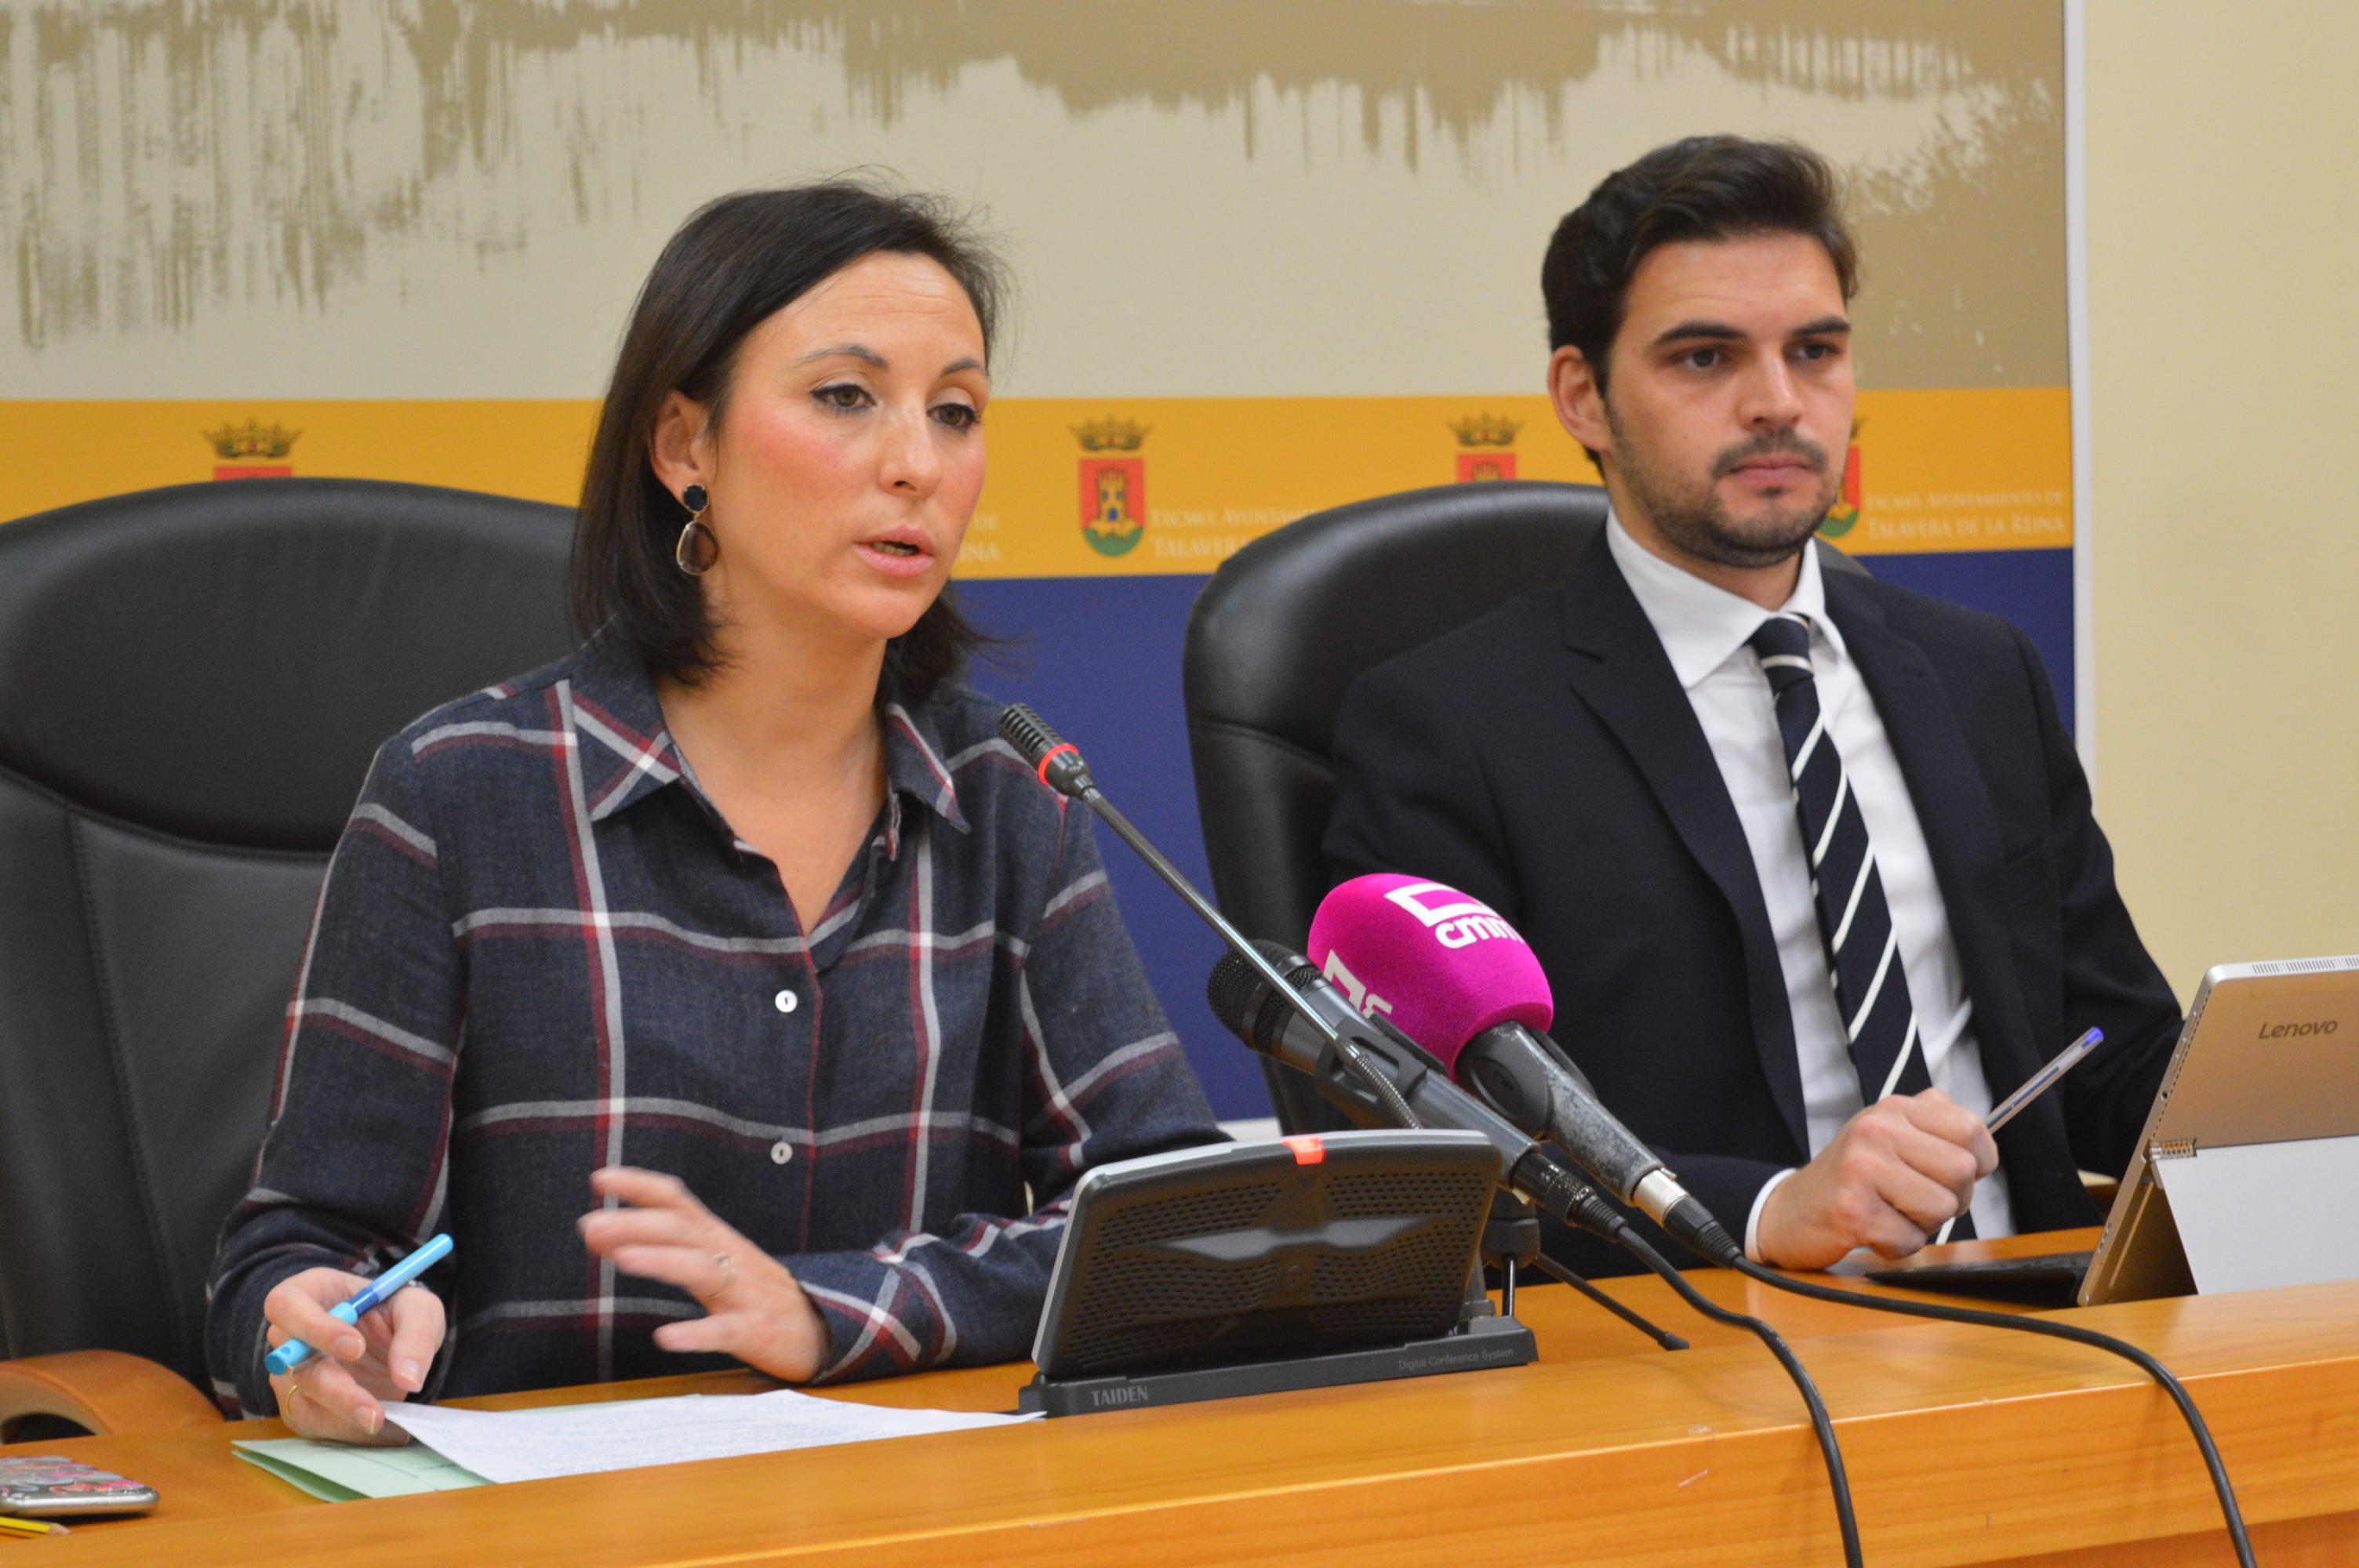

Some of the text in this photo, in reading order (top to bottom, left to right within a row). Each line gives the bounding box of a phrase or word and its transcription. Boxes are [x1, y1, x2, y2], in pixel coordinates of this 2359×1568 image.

[1866, 512, 2066, 539] TALAVERA DE LA REINA
[2259, 1021, 2339, 1039] Lenovo
[1398, 1348, 1514, 1371] Digital Conference System
[1091, 1385, 1148, 1406] TAIDEN
